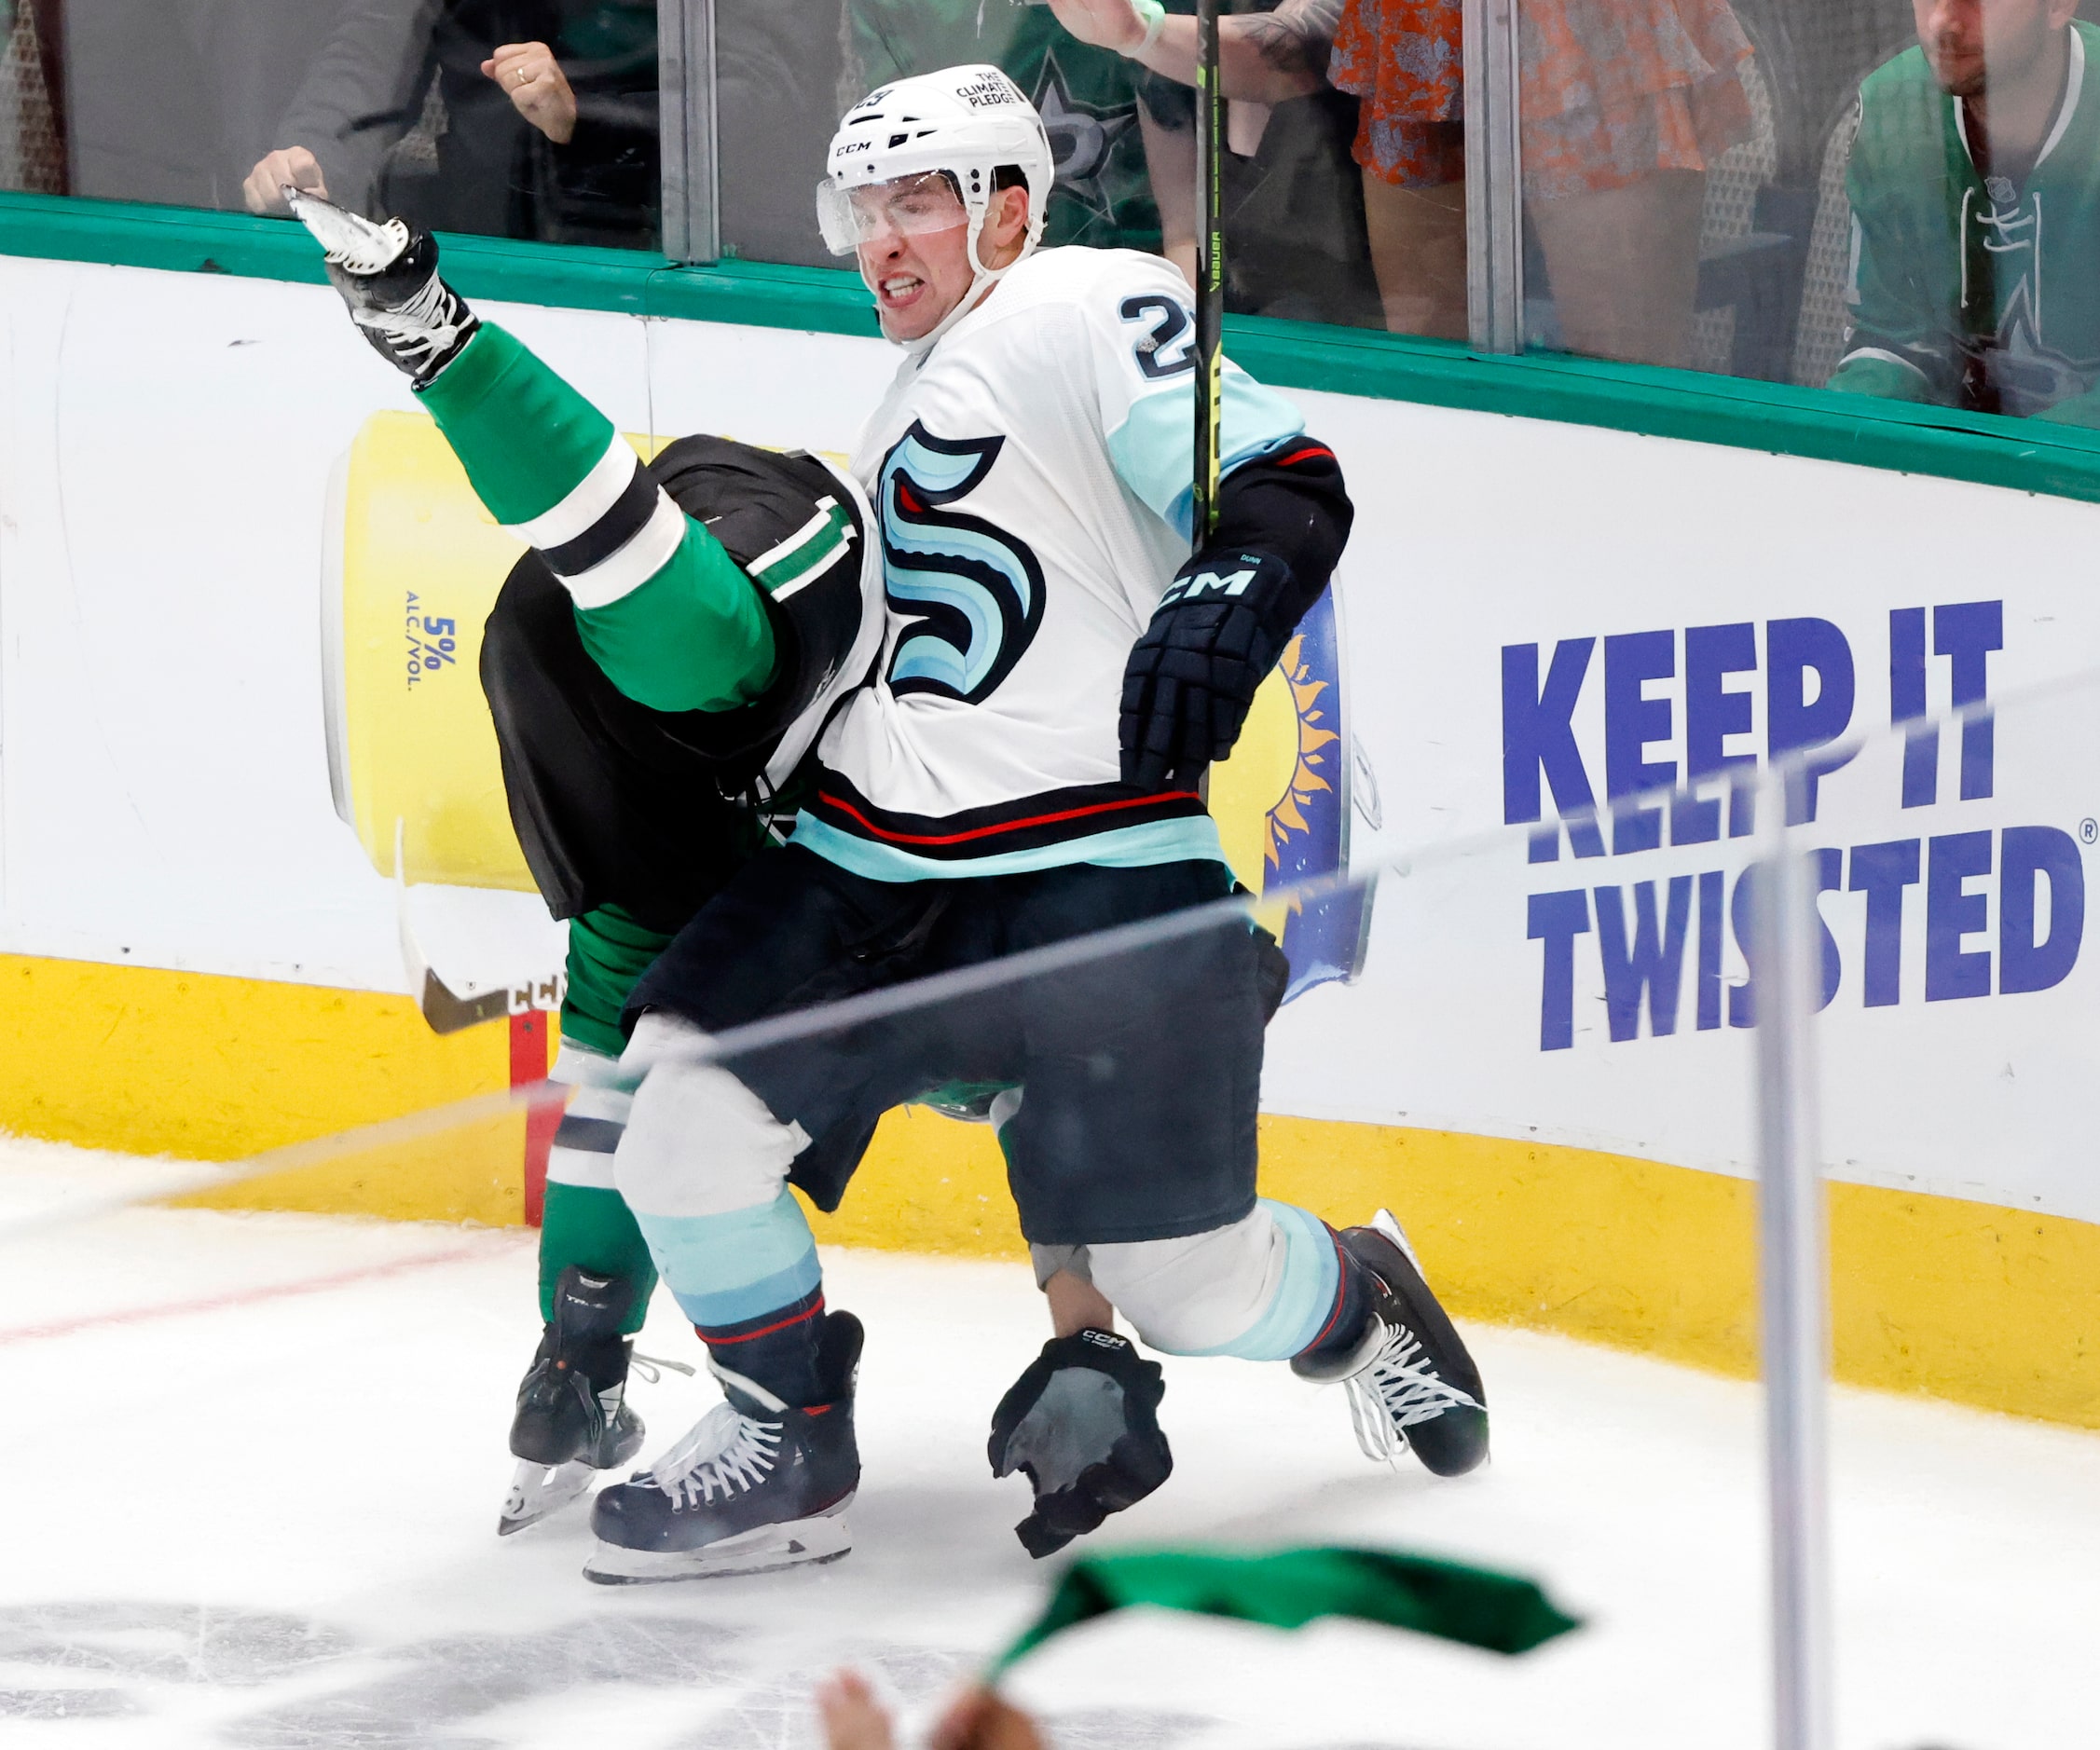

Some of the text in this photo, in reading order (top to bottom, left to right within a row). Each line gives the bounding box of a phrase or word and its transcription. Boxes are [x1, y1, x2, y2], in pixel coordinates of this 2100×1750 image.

[975, 72, 1002, 82] THE
[956, 82, 1009, 97] CLIMATE
[968, 93, 1016, 107] PLEDGE
[836, 141, 872, 157] CCM
[1118, 292, 1197, 382] 2
[1155, 569, 1257, 611] CM
[424, 616, 456, 670] 5%
[1501, 599, 2003, 864] KEEP IT
[1082, 1329, 1127, 1347] CCM
